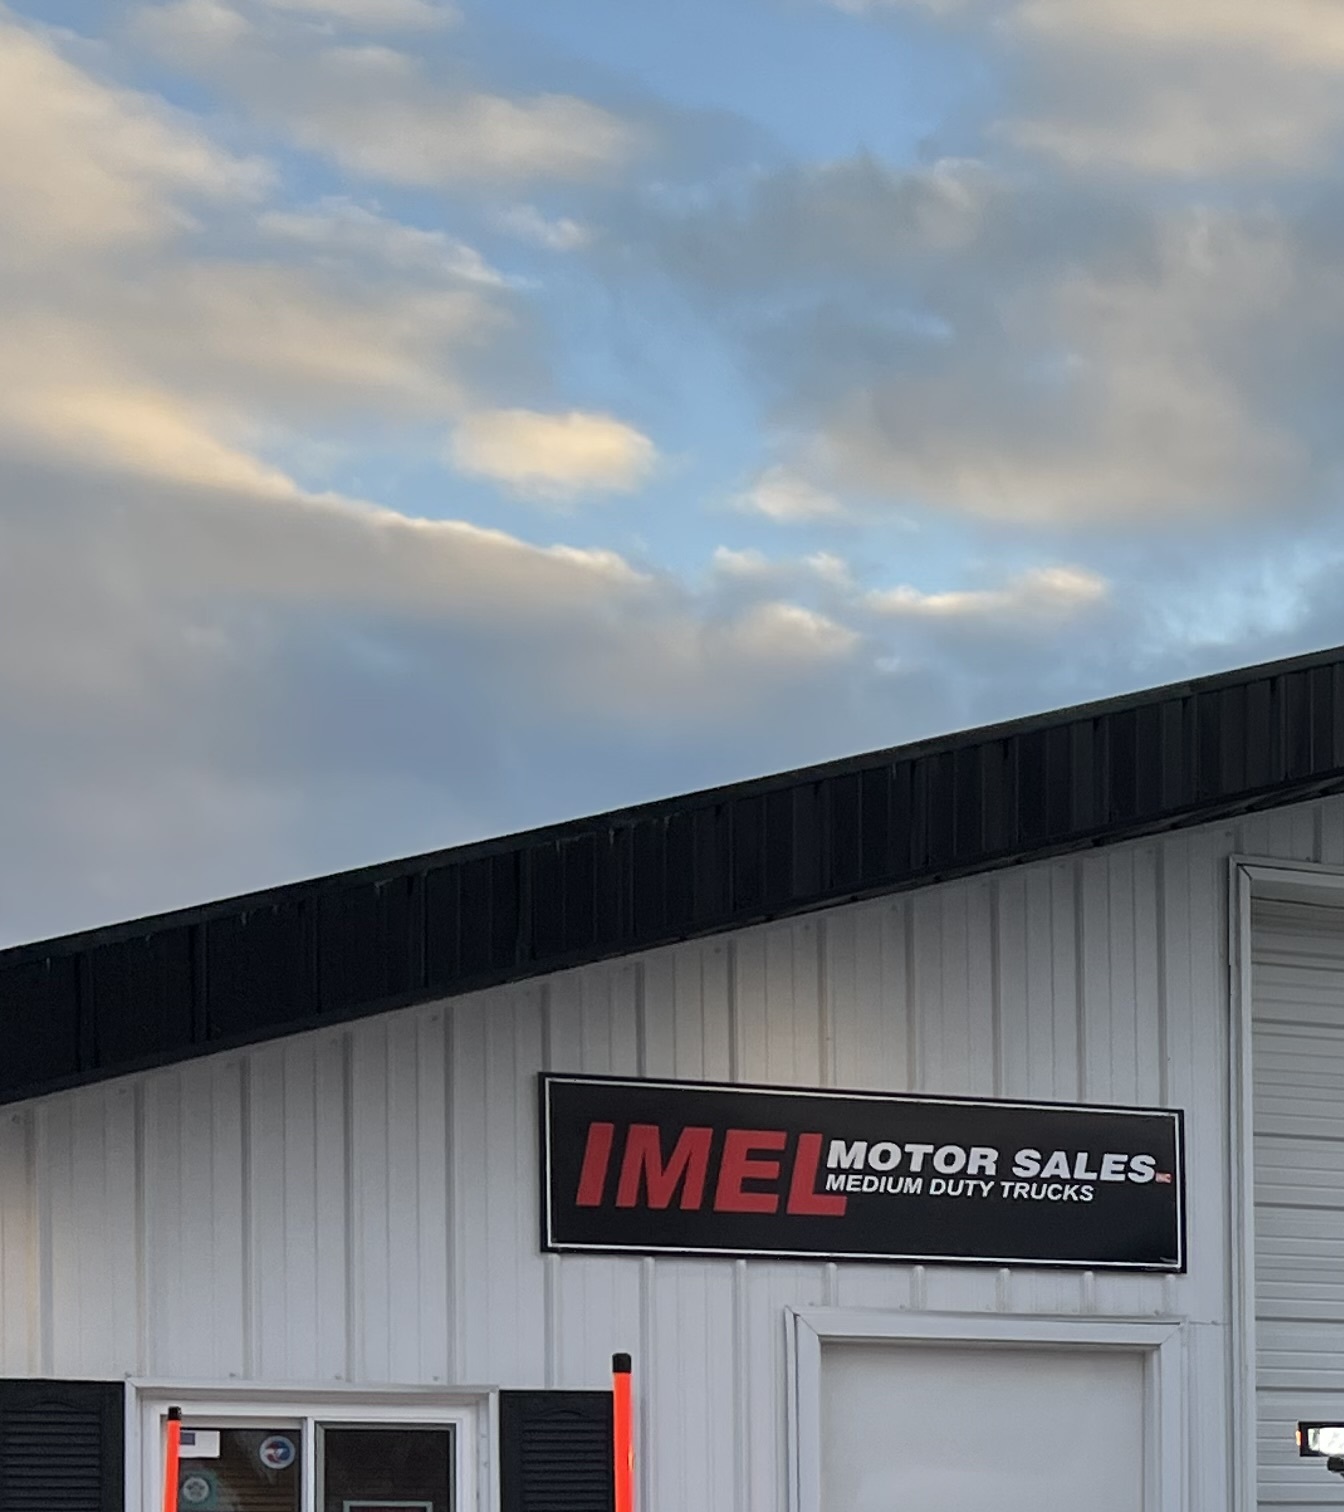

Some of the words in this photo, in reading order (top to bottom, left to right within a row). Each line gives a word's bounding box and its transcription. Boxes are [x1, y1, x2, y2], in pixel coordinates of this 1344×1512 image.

[575, 1122, 847, 1218] IMEL
[826, 1139, 998, 1176] MOTOR
[1011, 1149, 1157, 1184] SALES
[825, 1174, 923, 1195] MEDIUM
[929, 1177, 995, 1198] DUTY
[1000, 1180, 1095, 1202] TRUCKS
